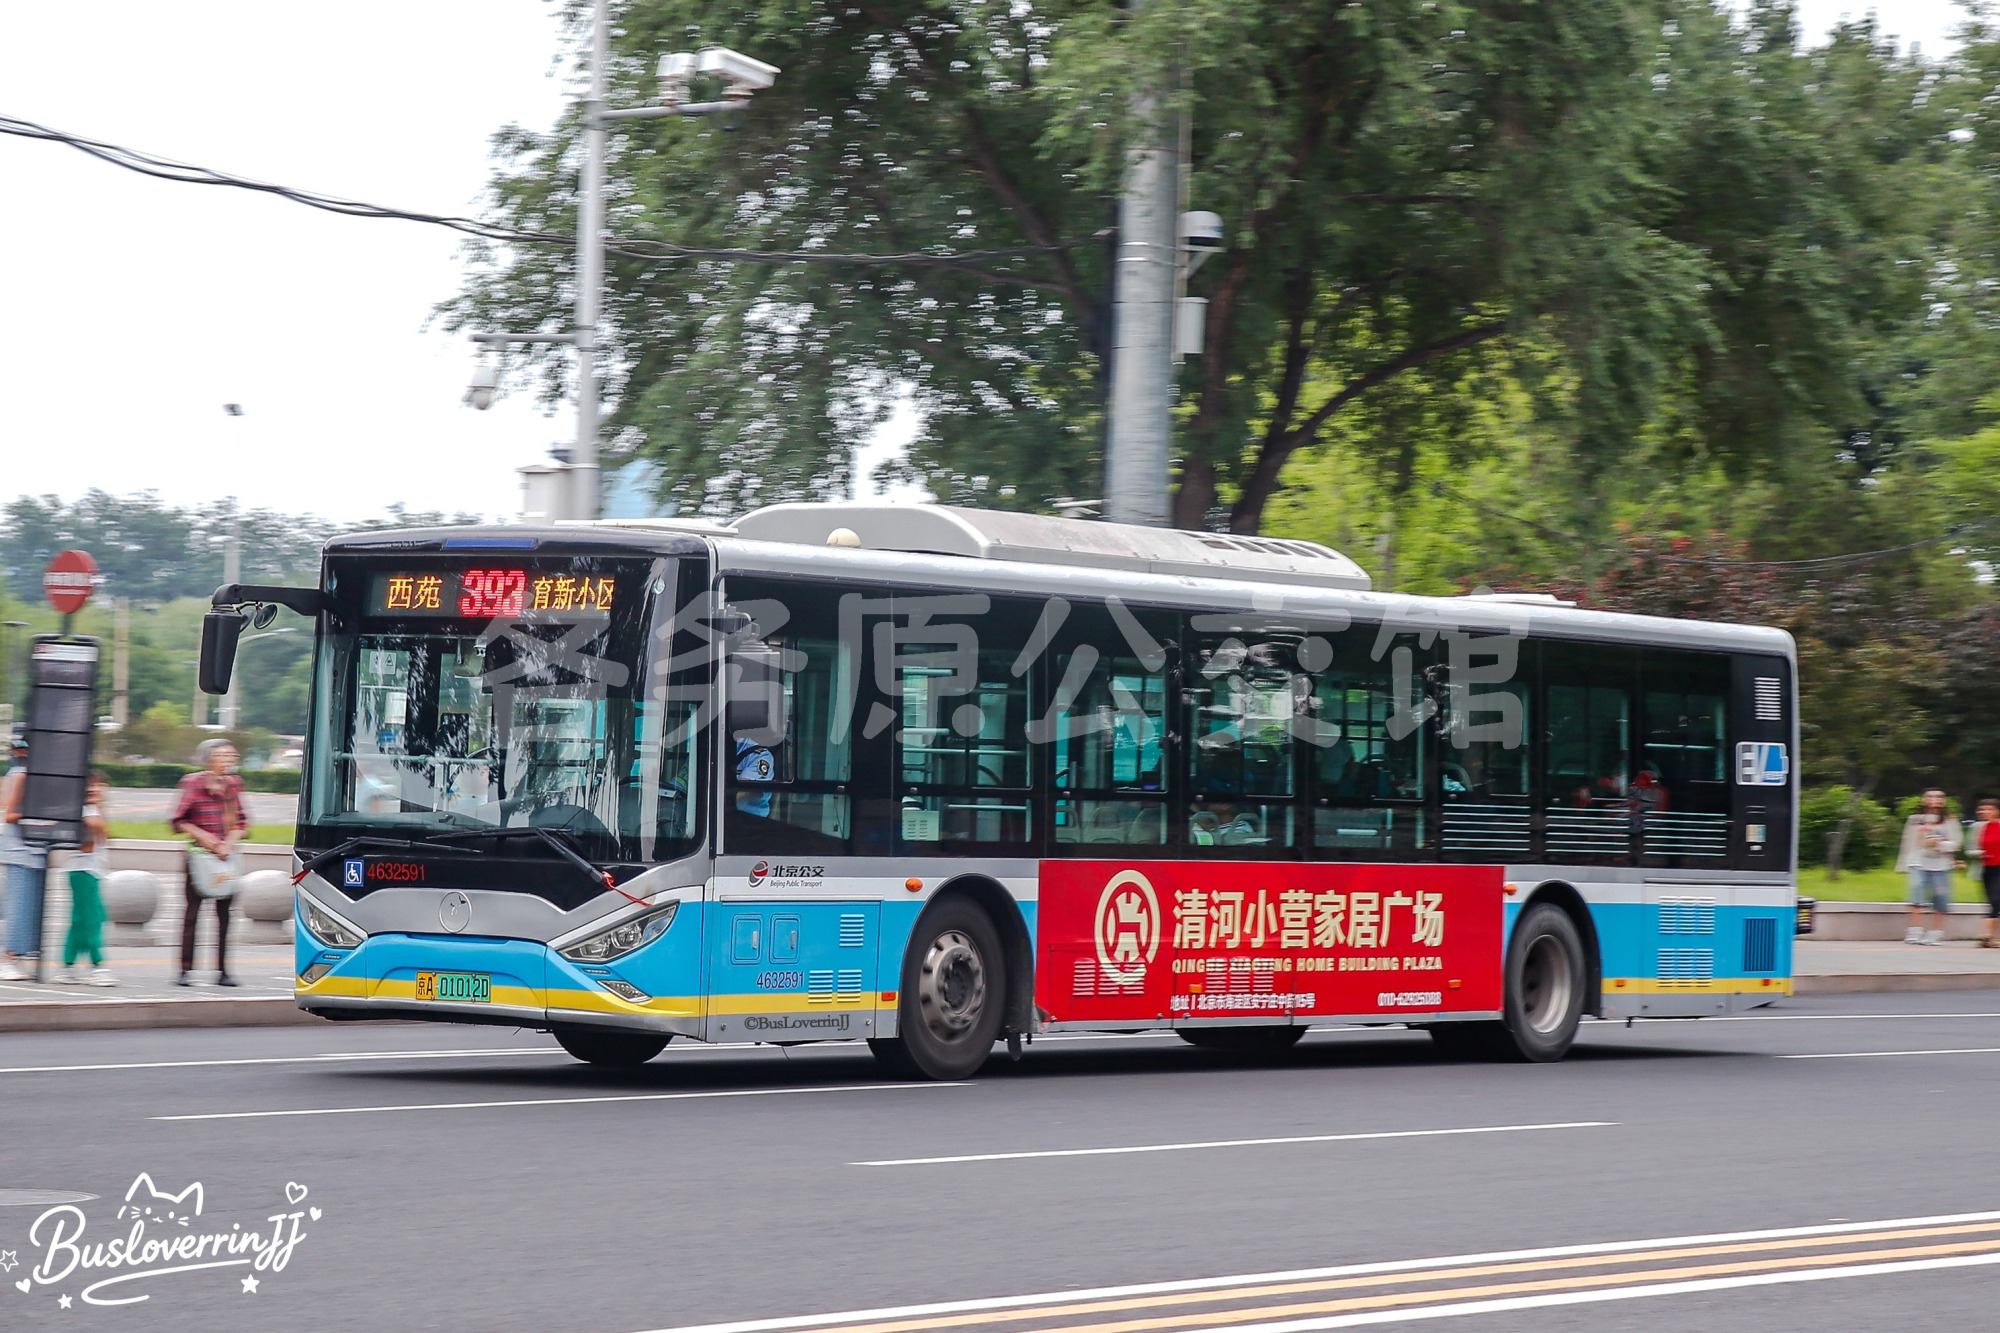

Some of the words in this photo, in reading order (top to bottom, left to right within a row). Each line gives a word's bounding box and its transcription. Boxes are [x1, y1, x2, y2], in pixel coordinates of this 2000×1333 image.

[387, 576, 443, 610] 西苑
[461, 570, 526, 616] 393
[533, 576, 615, 611] 育新小区
[367, 863, 425, 880] 4632591
[771, 865, 826, 878] 北京公交
[770, 880, 785, 888] Beijing
[800, 880, 823, 888] Transport
[1172, 888, 1445, 949] 清河小营家居广场
[1296, 957, 1335, 972] HOME
[1338, 957, 1399, 972] BUILDING
[1402, 957, 1443, 971] PLAZA
[757, 971, 805, 989] 4632591
